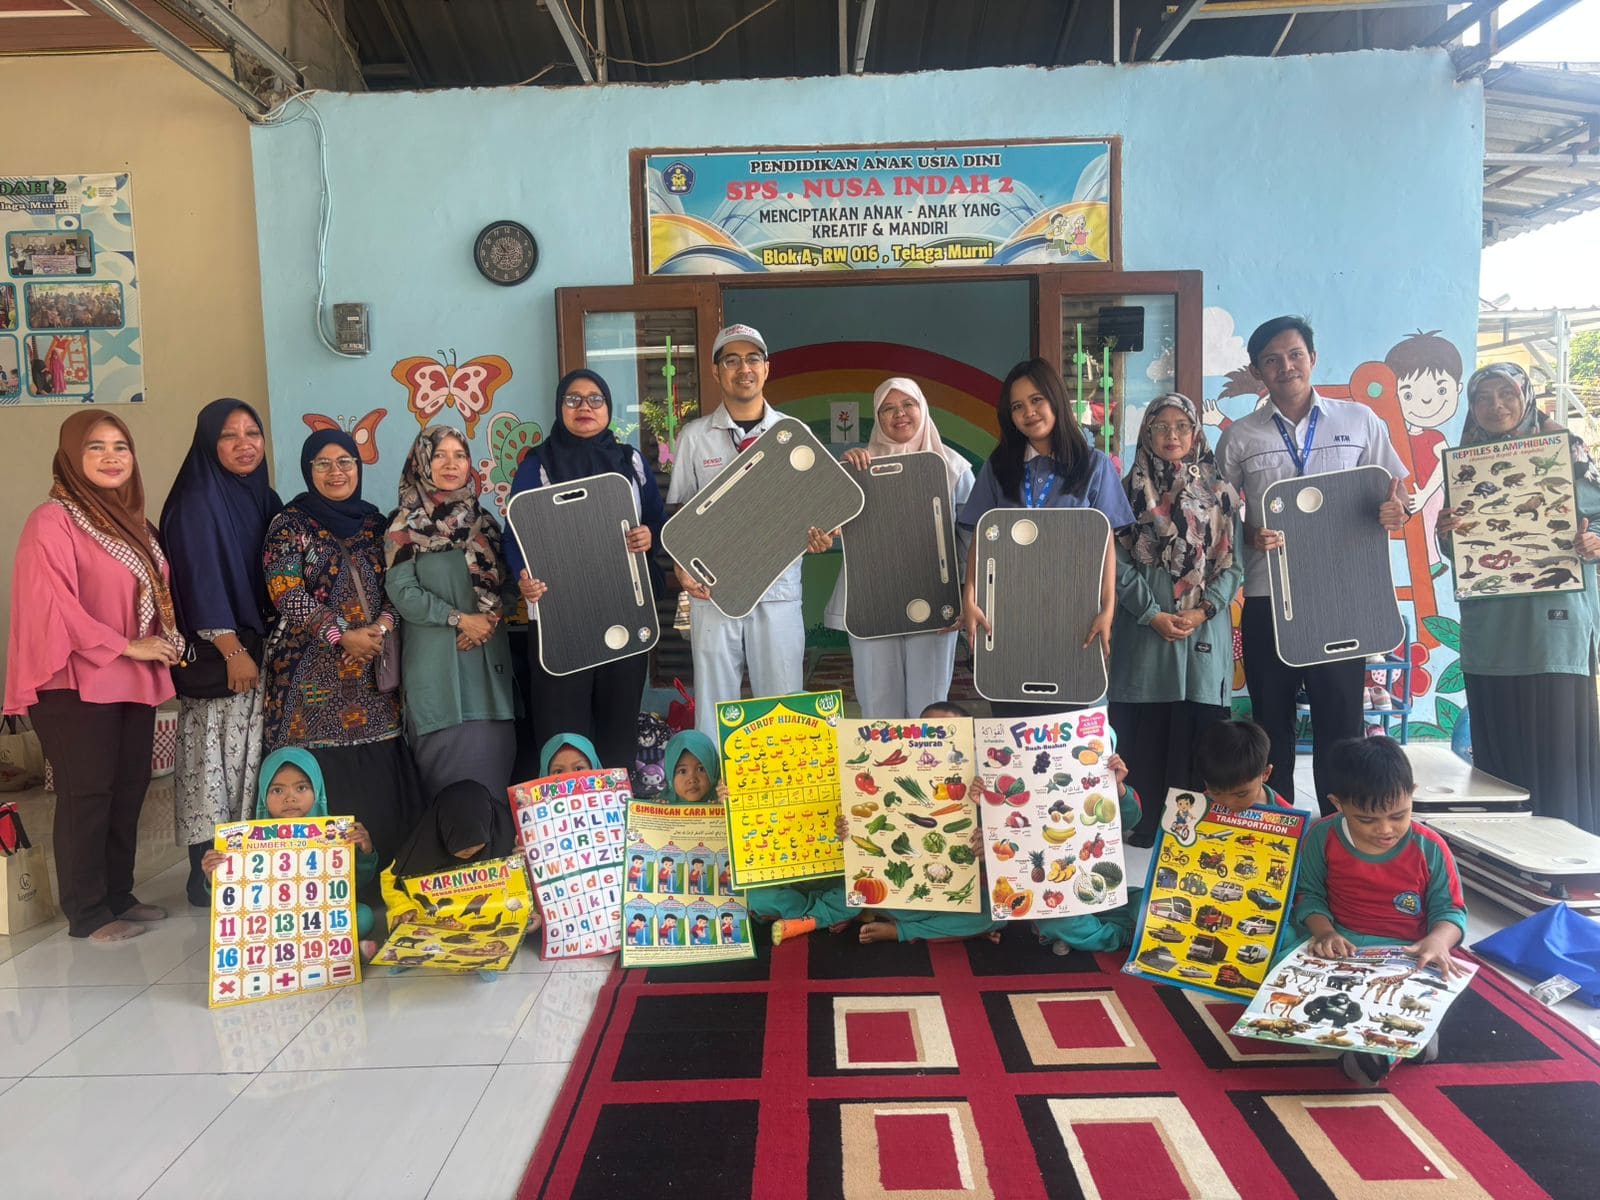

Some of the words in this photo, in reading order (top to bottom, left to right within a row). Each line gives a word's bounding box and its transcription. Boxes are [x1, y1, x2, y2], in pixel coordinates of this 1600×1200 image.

[751, 159, 858, 172] PENDIDIKAN
[863, 158, 913, 170] ANAK
[918, 156, 958, 168] USIA
[963, 154, 1000, 166] DINI
[53, 181, 66, 194] 2
[727, 182, 779, 203] SPS
[803, 178, 885, 198] NUSA
[894, 175, 990, 196] INDAH
[998, 177, 1014, 193] 2
[30, 200, 67, 209] Murni
[760, 207, 858, 223] MENCIPTAKAN
[864, 205, 902, 222] ANAK
[918, 204, 956, 218] ANAK
[961, 203, 1000, 216] YANG
[813, 224, 867, 238] KREATIF
[873, 223, 883, 235] &
[890, 221, 948, 235] MANDIRI
[762, 248, 798, 265] Blok
[800, 248, 818, 265] A,
[822, 247, 848, 263] RW
[851, 244, 878, 262] 016
[892, 244, 944, 262] Telaga
[947, 242, 993, 260] Murni
[1452, 447, 1491, 459] REPTILES
[1493, 445, 1500, 453] &
[1503, 436, 1561, 453] AMPHIBIANS
[744, 718, 775, 735] HURUF
[778, 715, 819, 728] HIJAIYAH
[858, 724, 947, 744] Vegetables
[1010, 722, 1072, 748] Fruits
[810, 733, 821, 742] ب
[909, 740, 942, 748] Sayuran
[532, 779, 576, 802] HURUF
[521, 811, 531, 823] A
[537, 806, 548, 818] B
[553, 802, 565, 813] C
[571, 799, 582, 810] D
[587, 796, 599, 807] E
[604, 795, 613, 805] F
[619, 793, 627, 804] G
[636, 805, 680, 816] BIMBINGAN
[683, 808, 706, 816] CARA
[248, 824, 322, 840] ANGKA
[524, 831, 536, 843] H
[543, 825, 548, 836] I
[558, 820, 567, 832] J
[574, 816, 585, 828] K
[592, 814, 602, 825] L
[606, 812, 619, 823] M
[1216, 815, 1288, 834] TRANSPORTATION
[529, 848, 540, 860] O
[544, 844, 554, 856] P
[560, 838, 572, 850] Q
[578, 834, 589, 846] R
[594, 831, 605, 843] S
[610, 829, 621, 841] T
[226, 856, 233, 875] 1
[252, 854, 264, 873] 2
[279, 853, 291, 871] 3
[306, 851, 317, 870] 4
[333, 850, 343, 868] 5
[534, 867, 543, 879] V
[547, 863, 560, 875] W
[565, 857, 575, 870] X
[580, 853, 591, 864] Y
[598, 849, 610, 861] Z
[420, 865, 509, 892] KARNIVORA
[543, 892, 551, 901] a
[556, 886, 564, 897] b
[570, 882, 580, 893] c
[587, 875, 596, 887] d
[604, 874, 613, 883] e
[223, 887, 235, 906] 6
[252, 885, 262, 904] 7
[279, 883, 291, 902] 8
[306, 882, 317, 901] 9
[329, 880, 348, 899] 10
[547, 909, 557, 920] h
[562, 903, 569, 915] i
[577, 898, 583, 914] j
[590, 895, 600, 907] k
[609, 890, 615, 902] l
[220, 918, 236, 937] 11
[247, 915, 266, 935] 12
[275, 914, 294, 932] 13
[302, 912, 321, 931] 14
[329, 910, 348, 928] 15
[551, 928, 559, 938] o
[566, 923, 574, 936] p
[580, 918, 589, 930] q
[595, 914, 601, 925] r
[611, 910, 620, 921] s
[217, 948, 238, 968] 16
[247, 946, 266, 965] 17
[275, 943, 295, 962] 18
[303, 941, 322, 959] 19
[329, 938, 351, 956] 20
[551, 945, 559, 954] v
[566, 941, 579, 952] w
[585, 939, 593, 948] x
[600, 934, 608, 947] y
